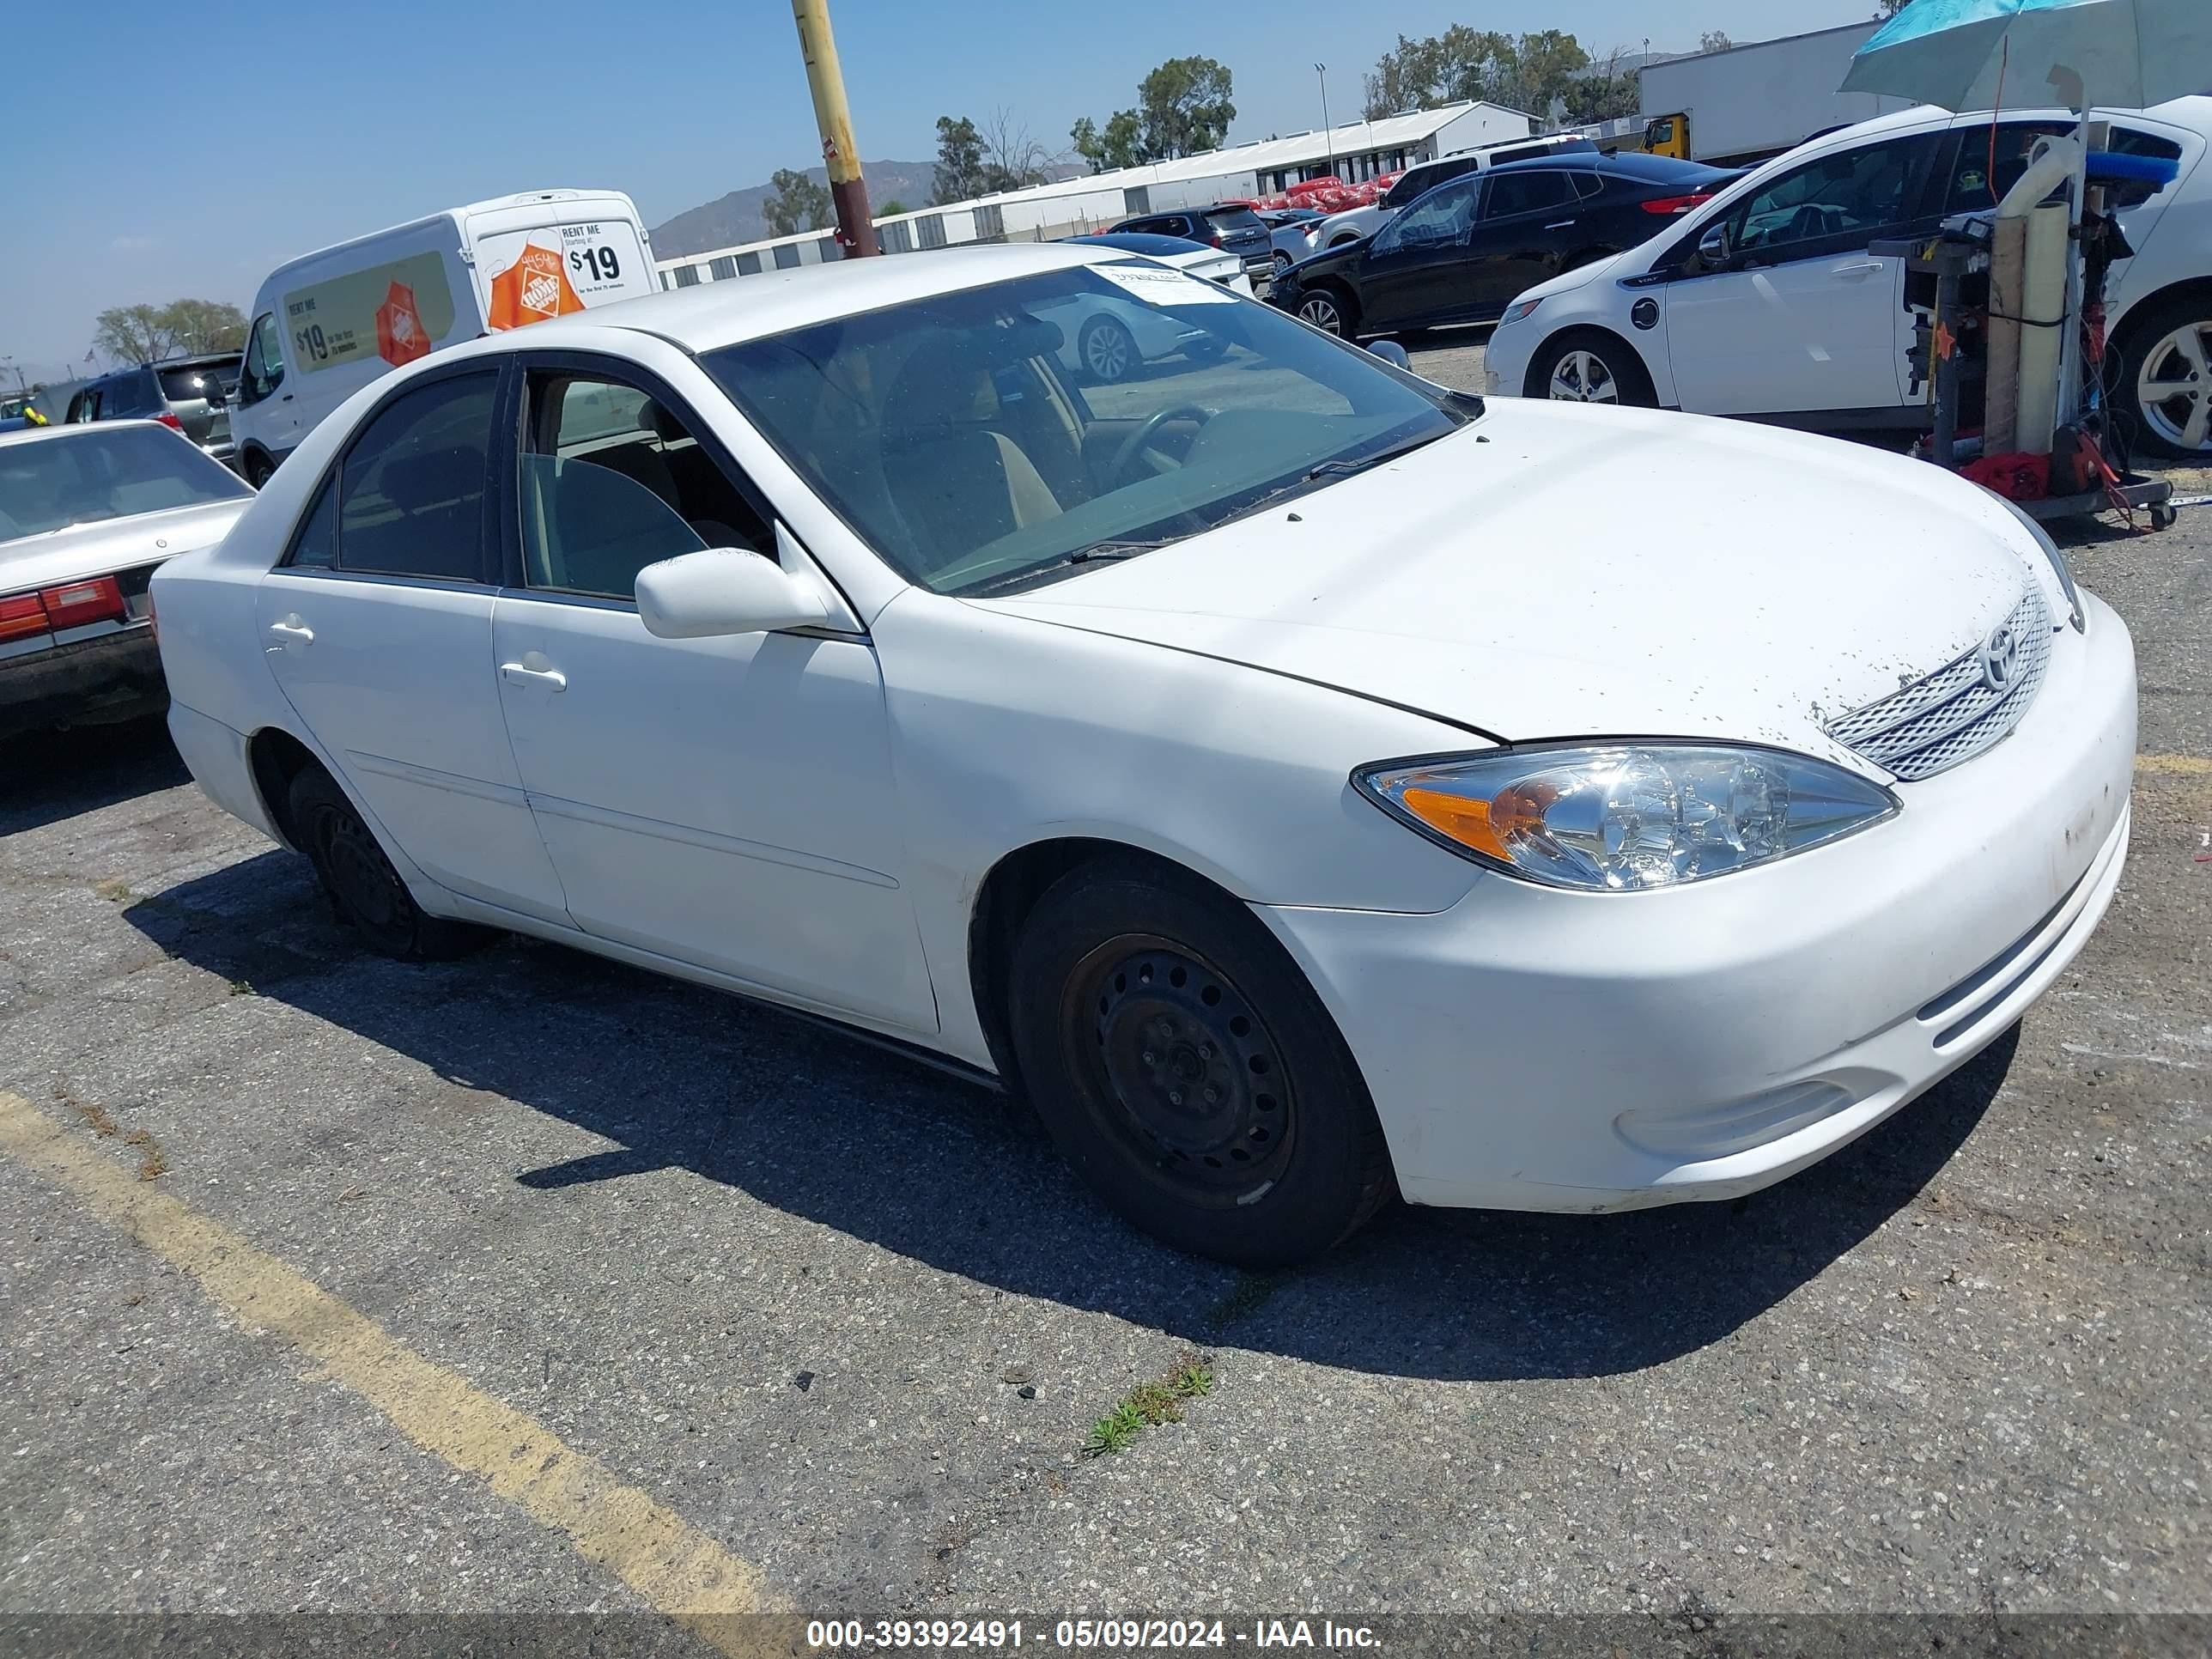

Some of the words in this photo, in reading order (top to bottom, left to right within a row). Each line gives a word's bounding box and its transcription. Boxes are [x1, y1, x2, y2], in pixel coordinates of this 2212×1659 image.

[562, 226, 585, 239] RENT
[586, 224, 601, 235] ME
[569, 246, 620, 282] $19
[295, 323, 328, 362] $19
